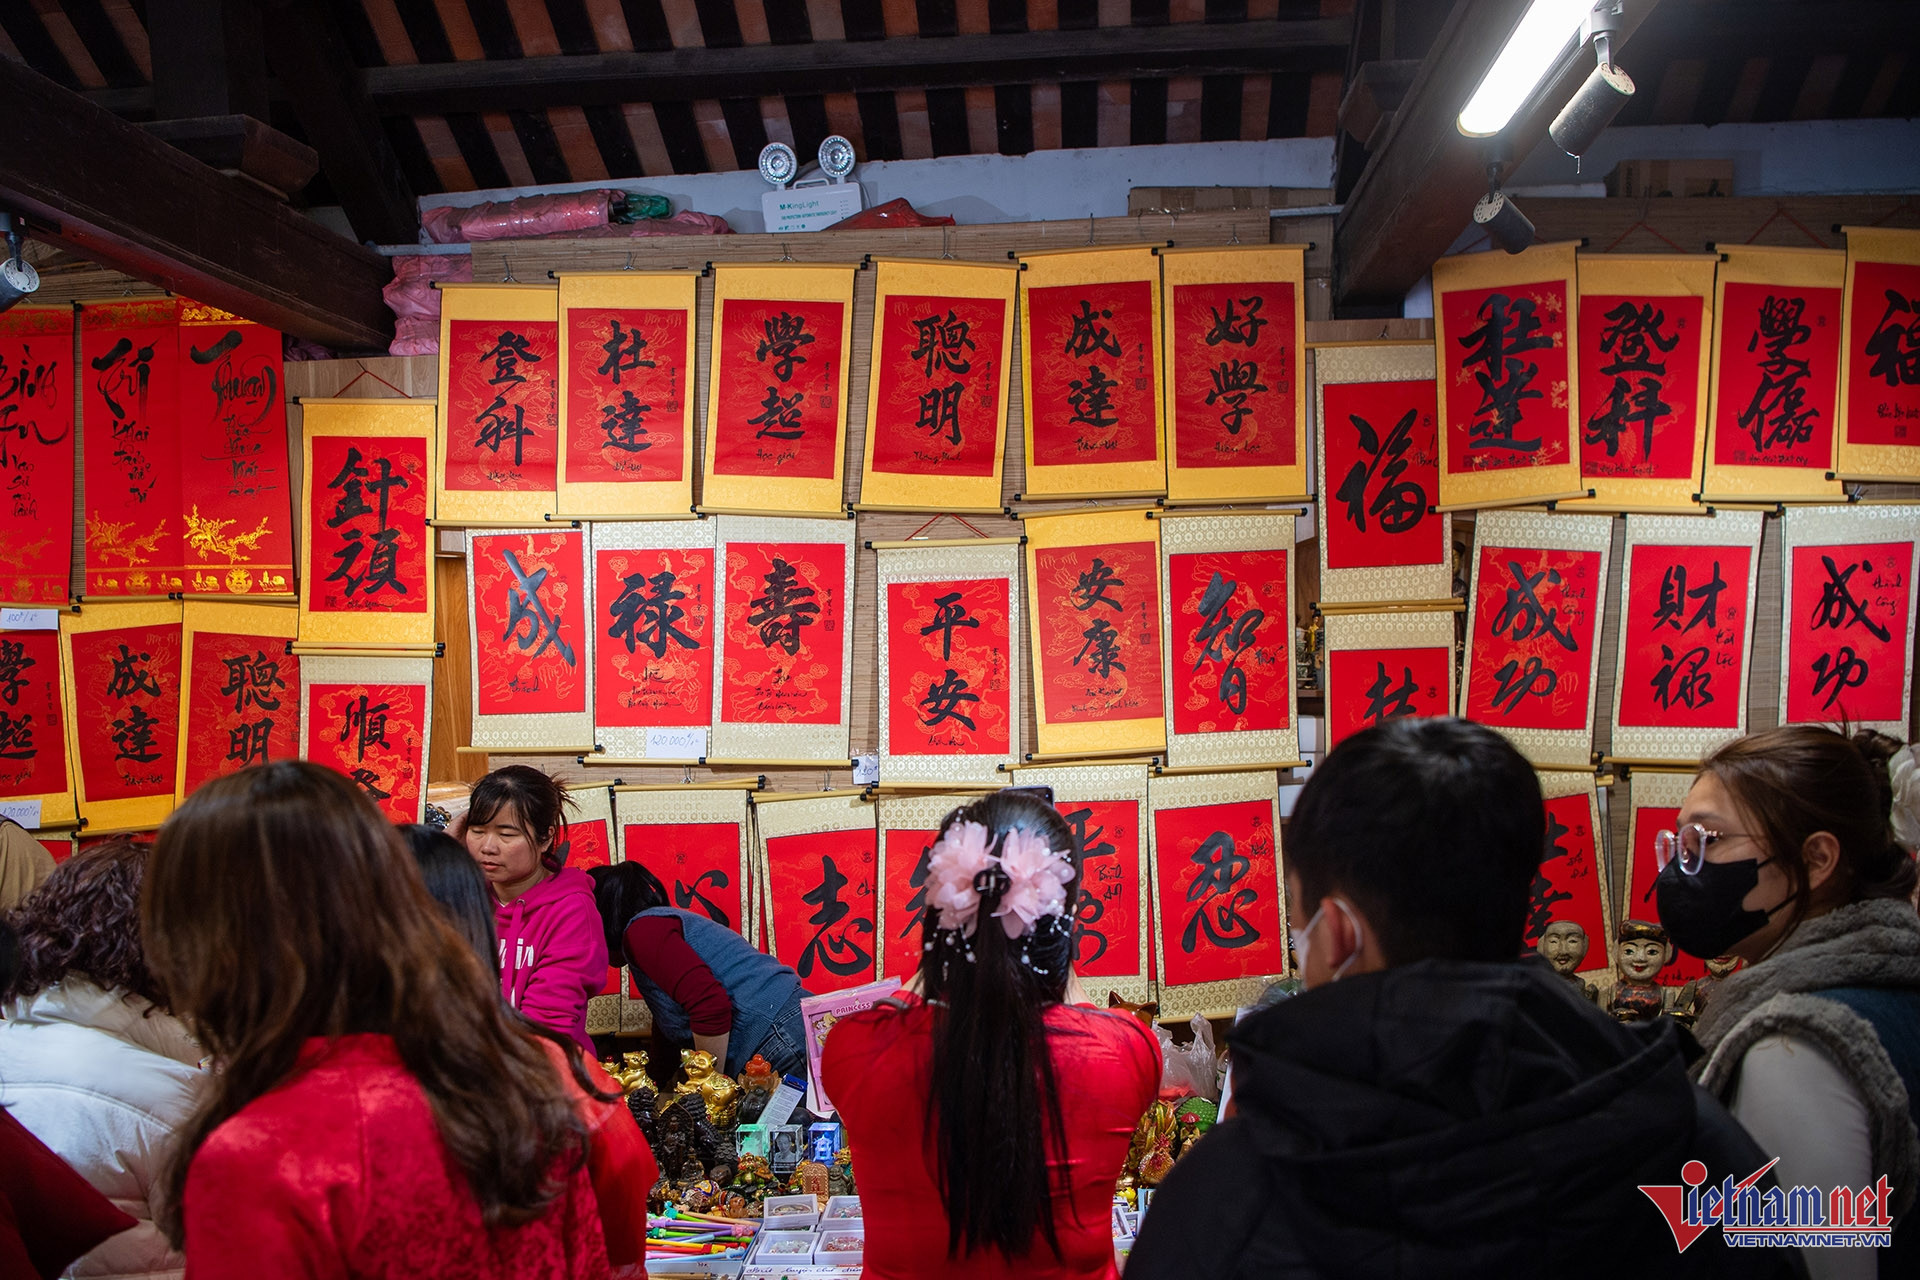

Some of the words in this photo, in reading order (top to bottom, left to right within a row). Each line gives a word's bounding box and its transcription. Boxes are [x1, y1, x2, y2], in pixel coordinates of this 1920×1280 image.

[475, 331, 541, 467] 登科
[598, 320, 656, 453] 杜達
[747, 312, 815, 440] 學超
[911, 310, 976, 446] 聰明
[1065, 300, 1122, 428] 成達
[1205, 296, 1268, 434] 好學
[1336, 408, 1427, 534] 福
[503, 550, 576, 667] 成
[747, 558, 820, 656] 壽
[920, 592, 980, 731] 平安
[1072, 558, 1126, 679] 安康
[1193, 571, 1265, 716] 智
[1491, 561, 1579, 716] 成功
[1811, 555, 1891, 712] 成功
[106, 644, 163, 763] 成達
[220, 650, 286, 769] 聰明
[796, 855, 874, 979] 志
[1181, 831, 1261, 954] 忍
[835, 1002, 872, 1015] PRINCESS
